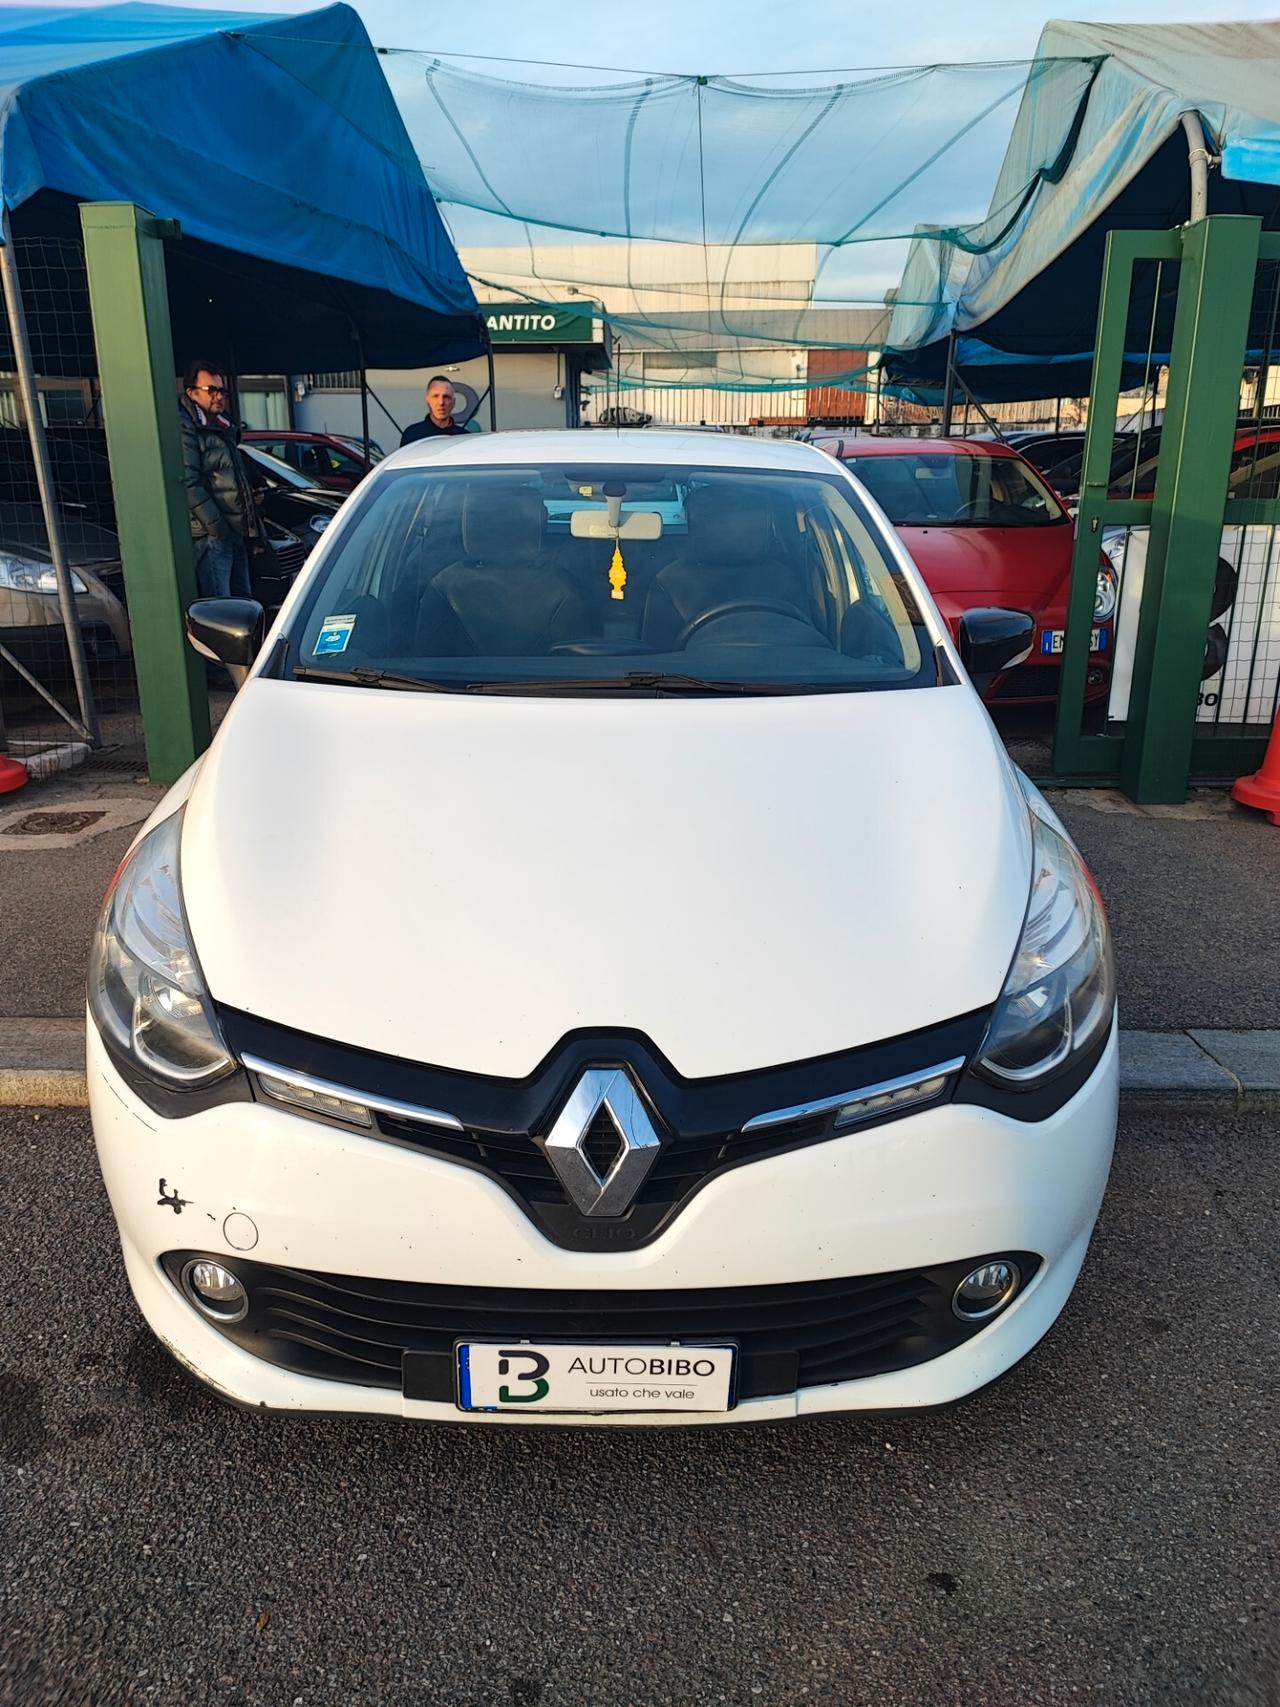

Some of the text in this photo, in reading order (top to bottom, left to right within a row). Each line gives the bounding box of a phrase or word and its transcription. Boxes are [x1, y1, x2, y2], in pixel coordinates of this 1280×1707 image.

[486, 314, 556, 331] ANTITO
[567, 1357, 716, 1377] AUTOBIBO
[589, 1387, 695, 1399] usato che vale
